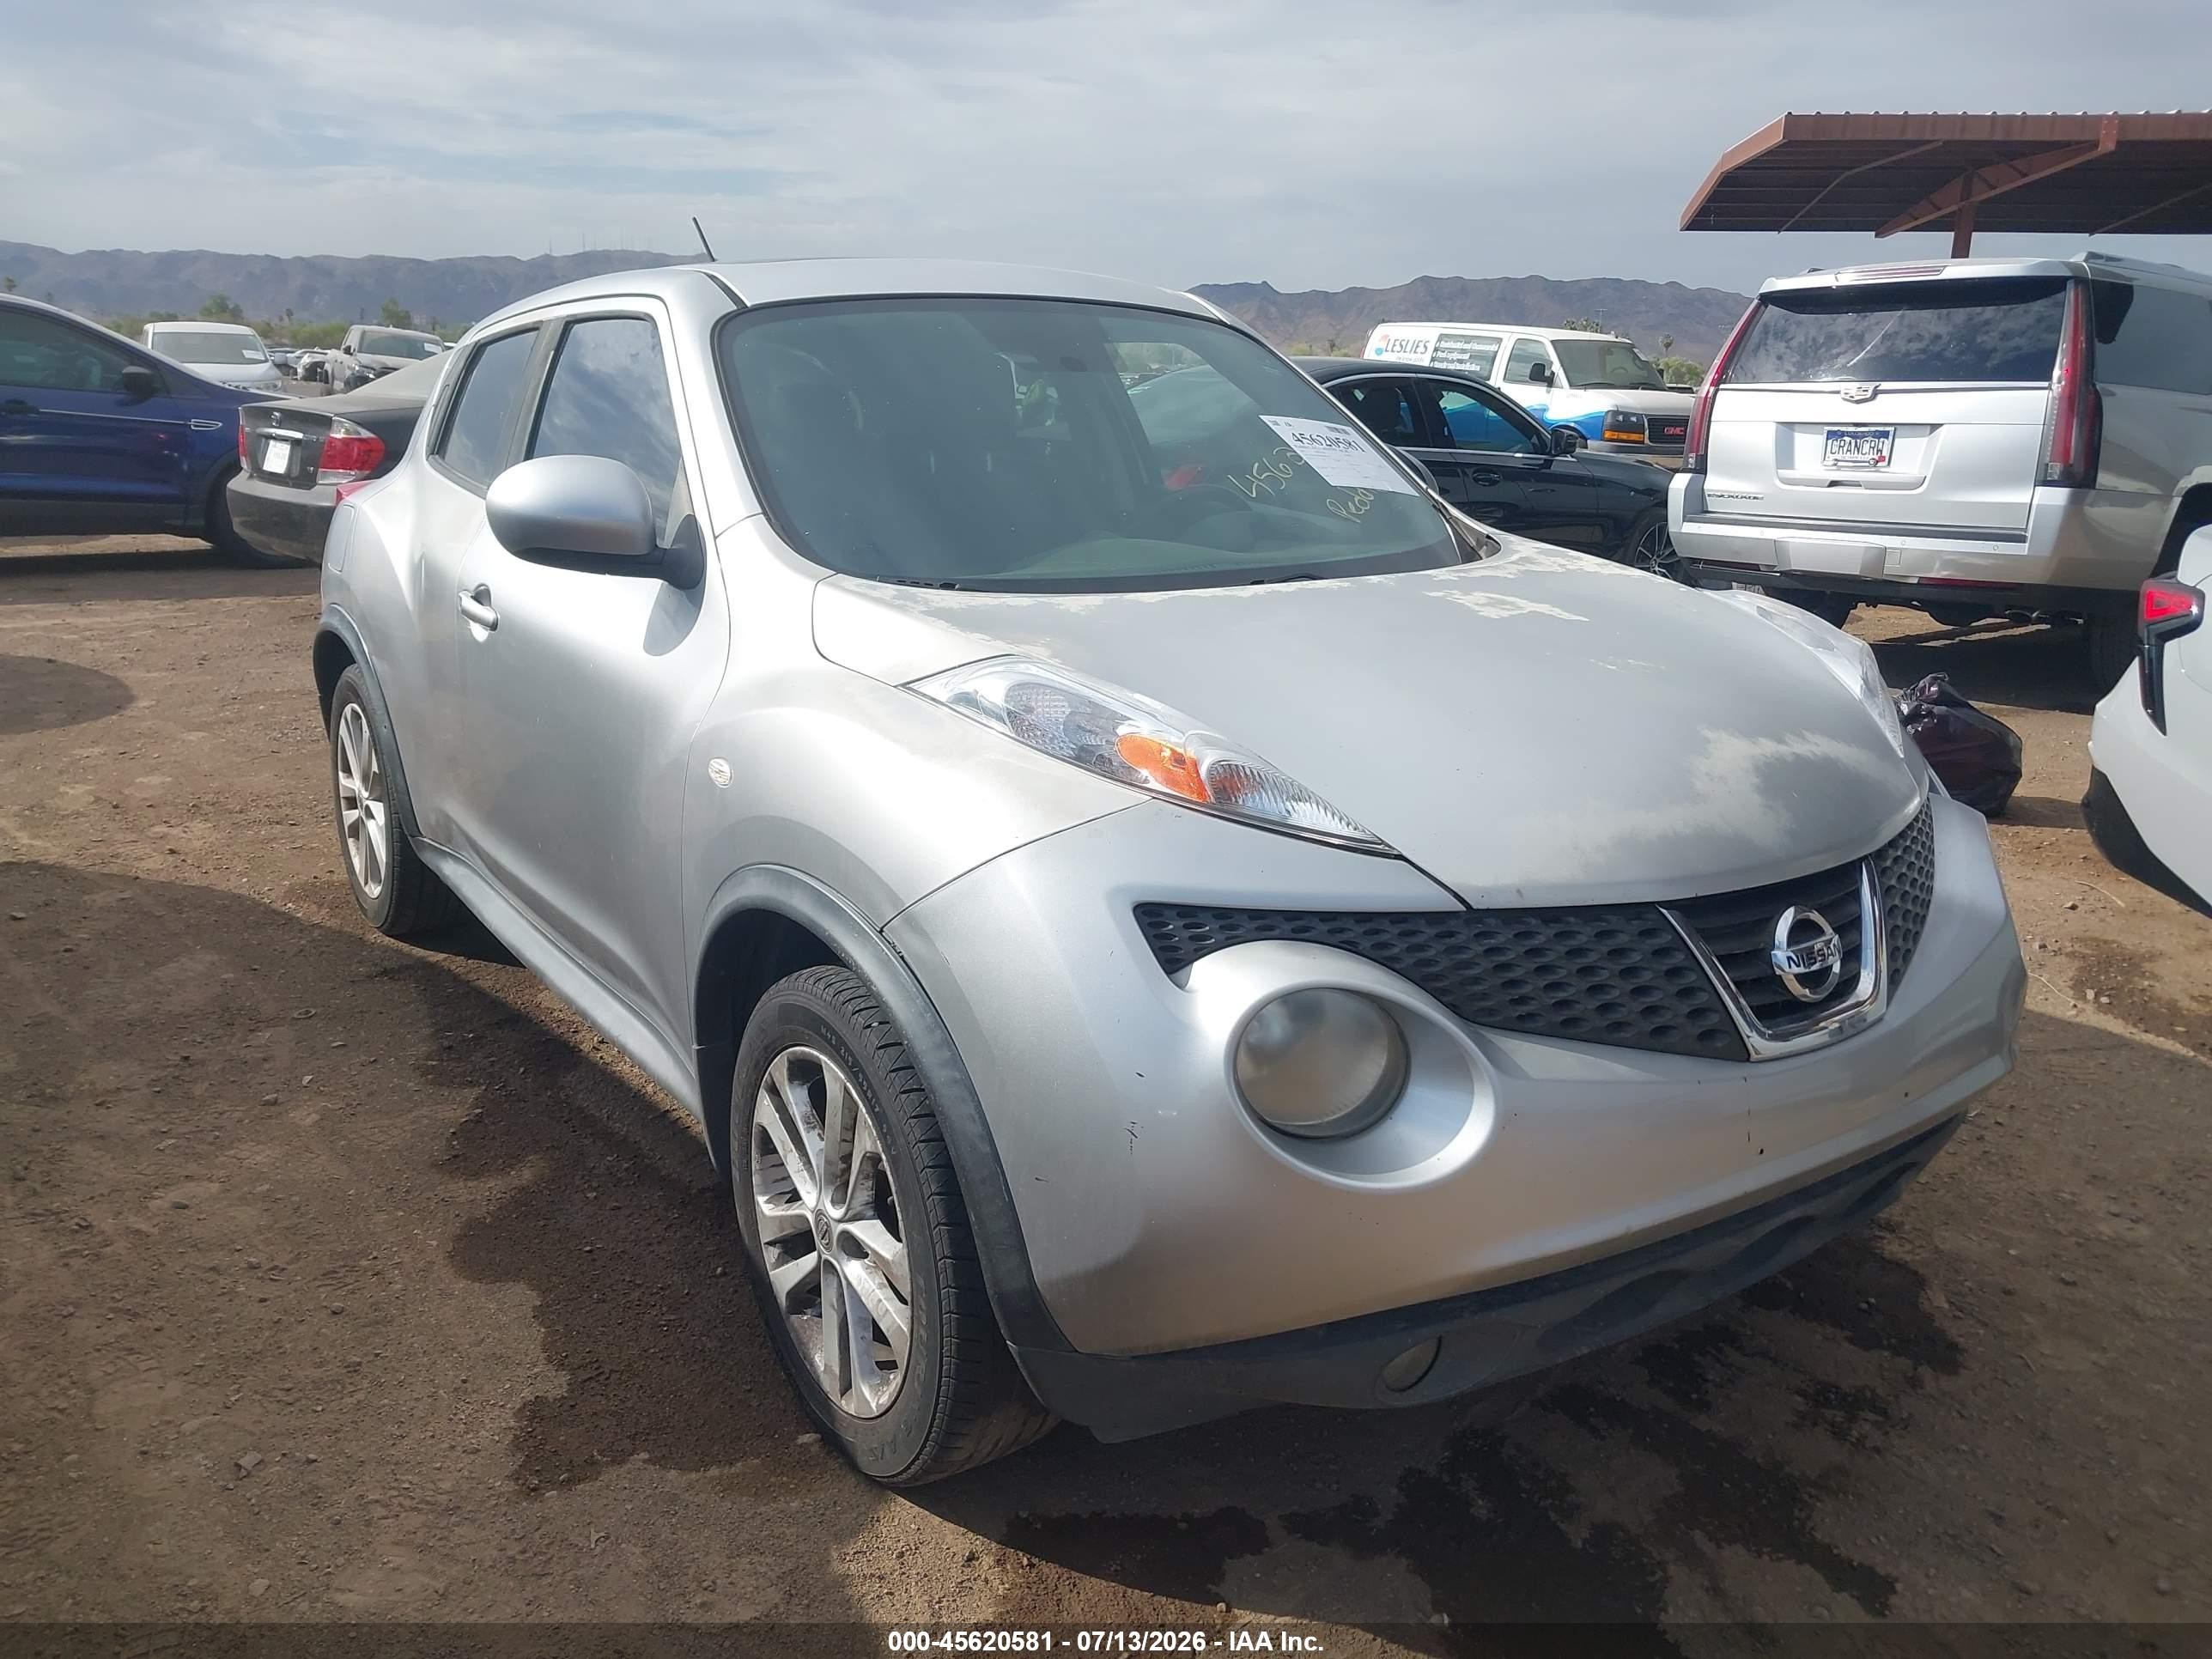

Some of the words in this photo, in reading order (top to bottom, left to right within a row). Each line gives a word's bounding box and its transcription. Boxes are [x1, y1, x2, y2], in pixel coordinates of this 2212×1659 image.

[1384, 338, 1431, 354] LESLIES
[1664, 426, 1685, 435] GMC
[1291, 432, 1366, 453] 45620581
[1785, 943, 1842, 969] NISSAN
